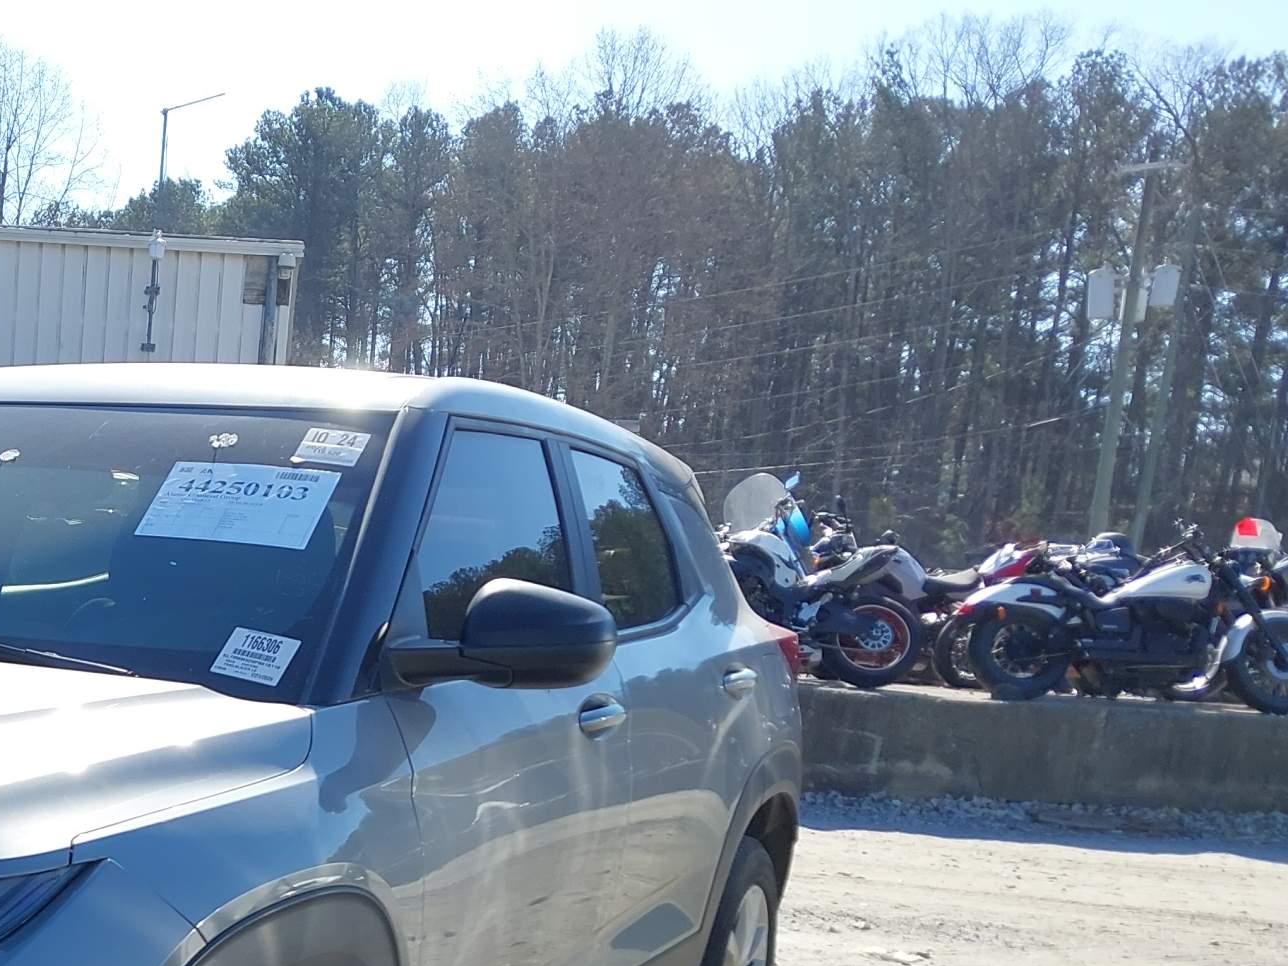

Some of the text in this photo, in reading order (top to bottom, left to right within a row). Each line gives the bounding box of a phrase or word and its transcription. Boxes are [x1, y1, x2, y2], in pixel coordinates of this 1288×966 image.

[312, 431, 358, 447] 10 24
[178, 479, 309, 501] 44250103
[242, 633, 283, 654] 1166306
